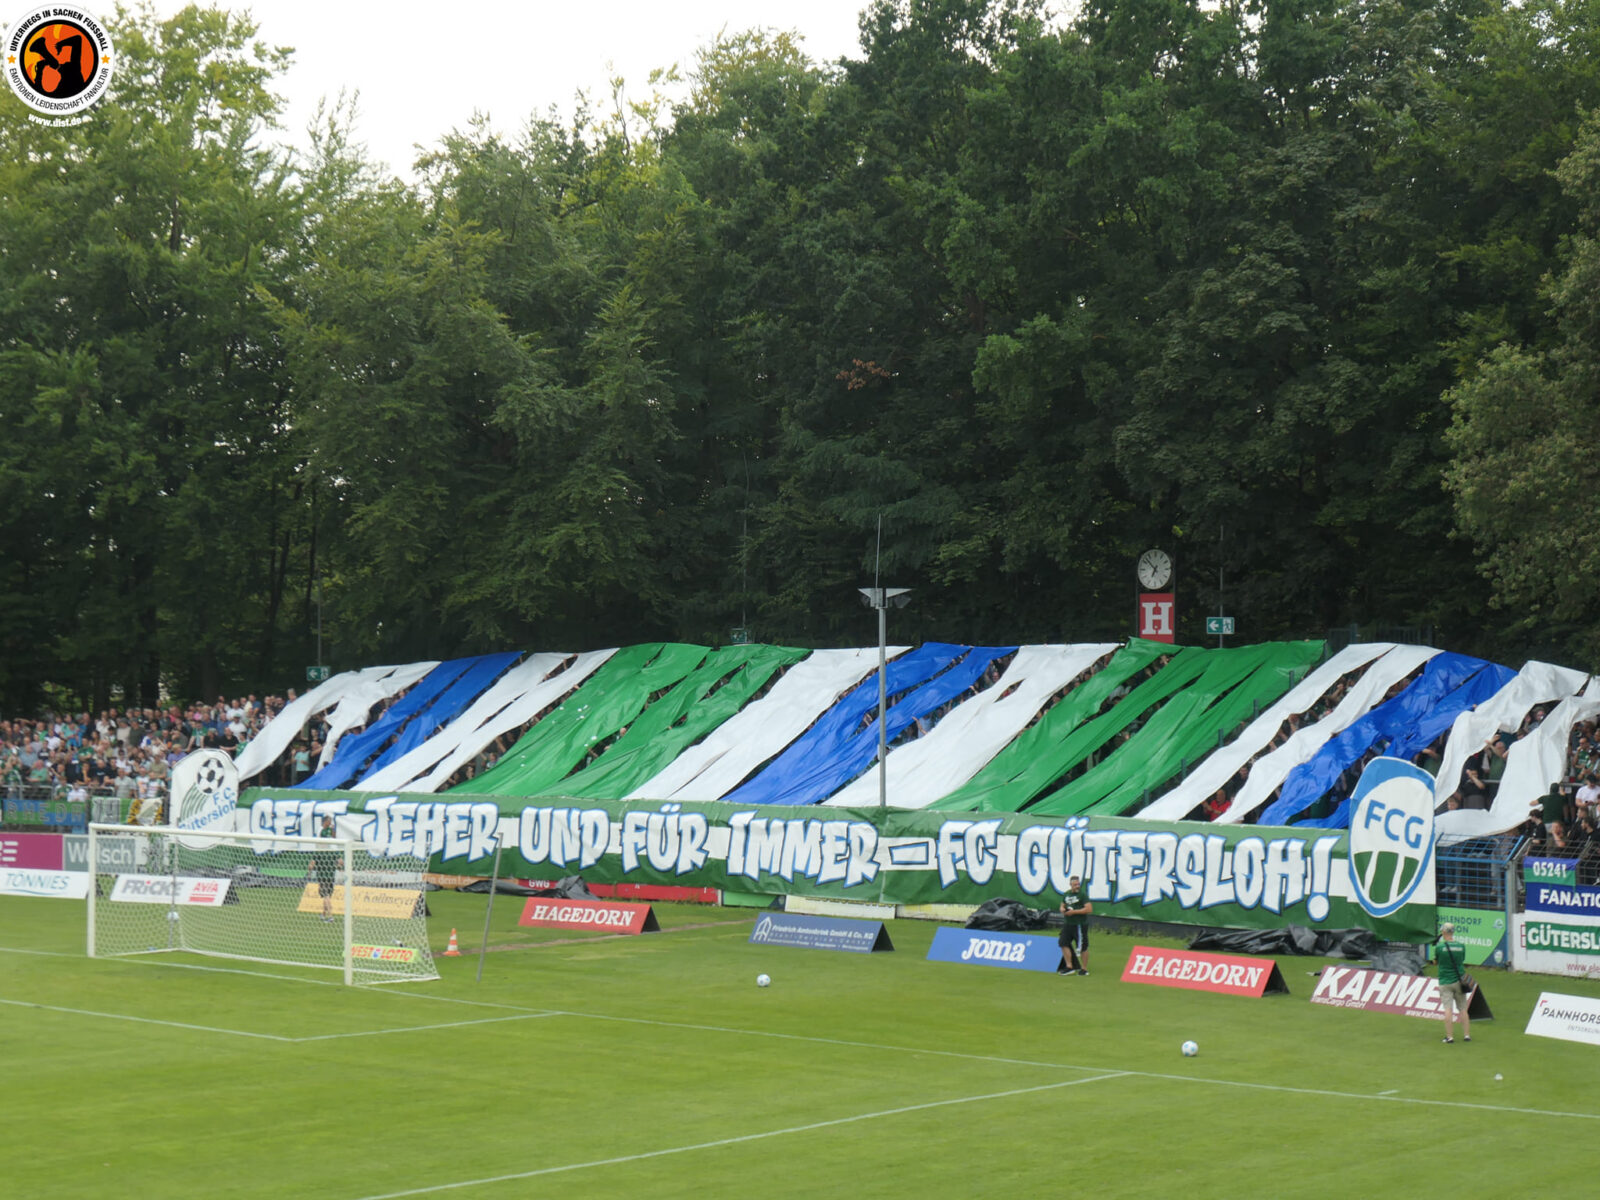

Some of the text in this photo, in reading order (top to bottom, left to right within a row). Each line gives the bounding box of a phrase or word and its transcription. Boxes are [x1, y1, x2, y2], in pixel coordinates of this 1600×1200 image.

[1142, 602, 1172, 635] H
[1364, 800, 1425, 849] FCG
[67, 841, 132, 865] Wlsch
[250, 798, 350, 856] SEIT
[361, 796, 499, 862] JEHER
[518, 806, 610, 869] UND
[620, 803, 709, 876] FÜR
[726, 809, 882, 889] IMMER
[936, 818, 1004, 889] FC
[1015, 815, 1343, 922] GÜTERSLOH!
[1533, 861, 1567, 878] 05241
[532, 905, 635, 927] HAGEDORN
[1527, 924, 1600, 950] GÜTERSL
[1130, 954, 1264, 988] HAGEDORN
